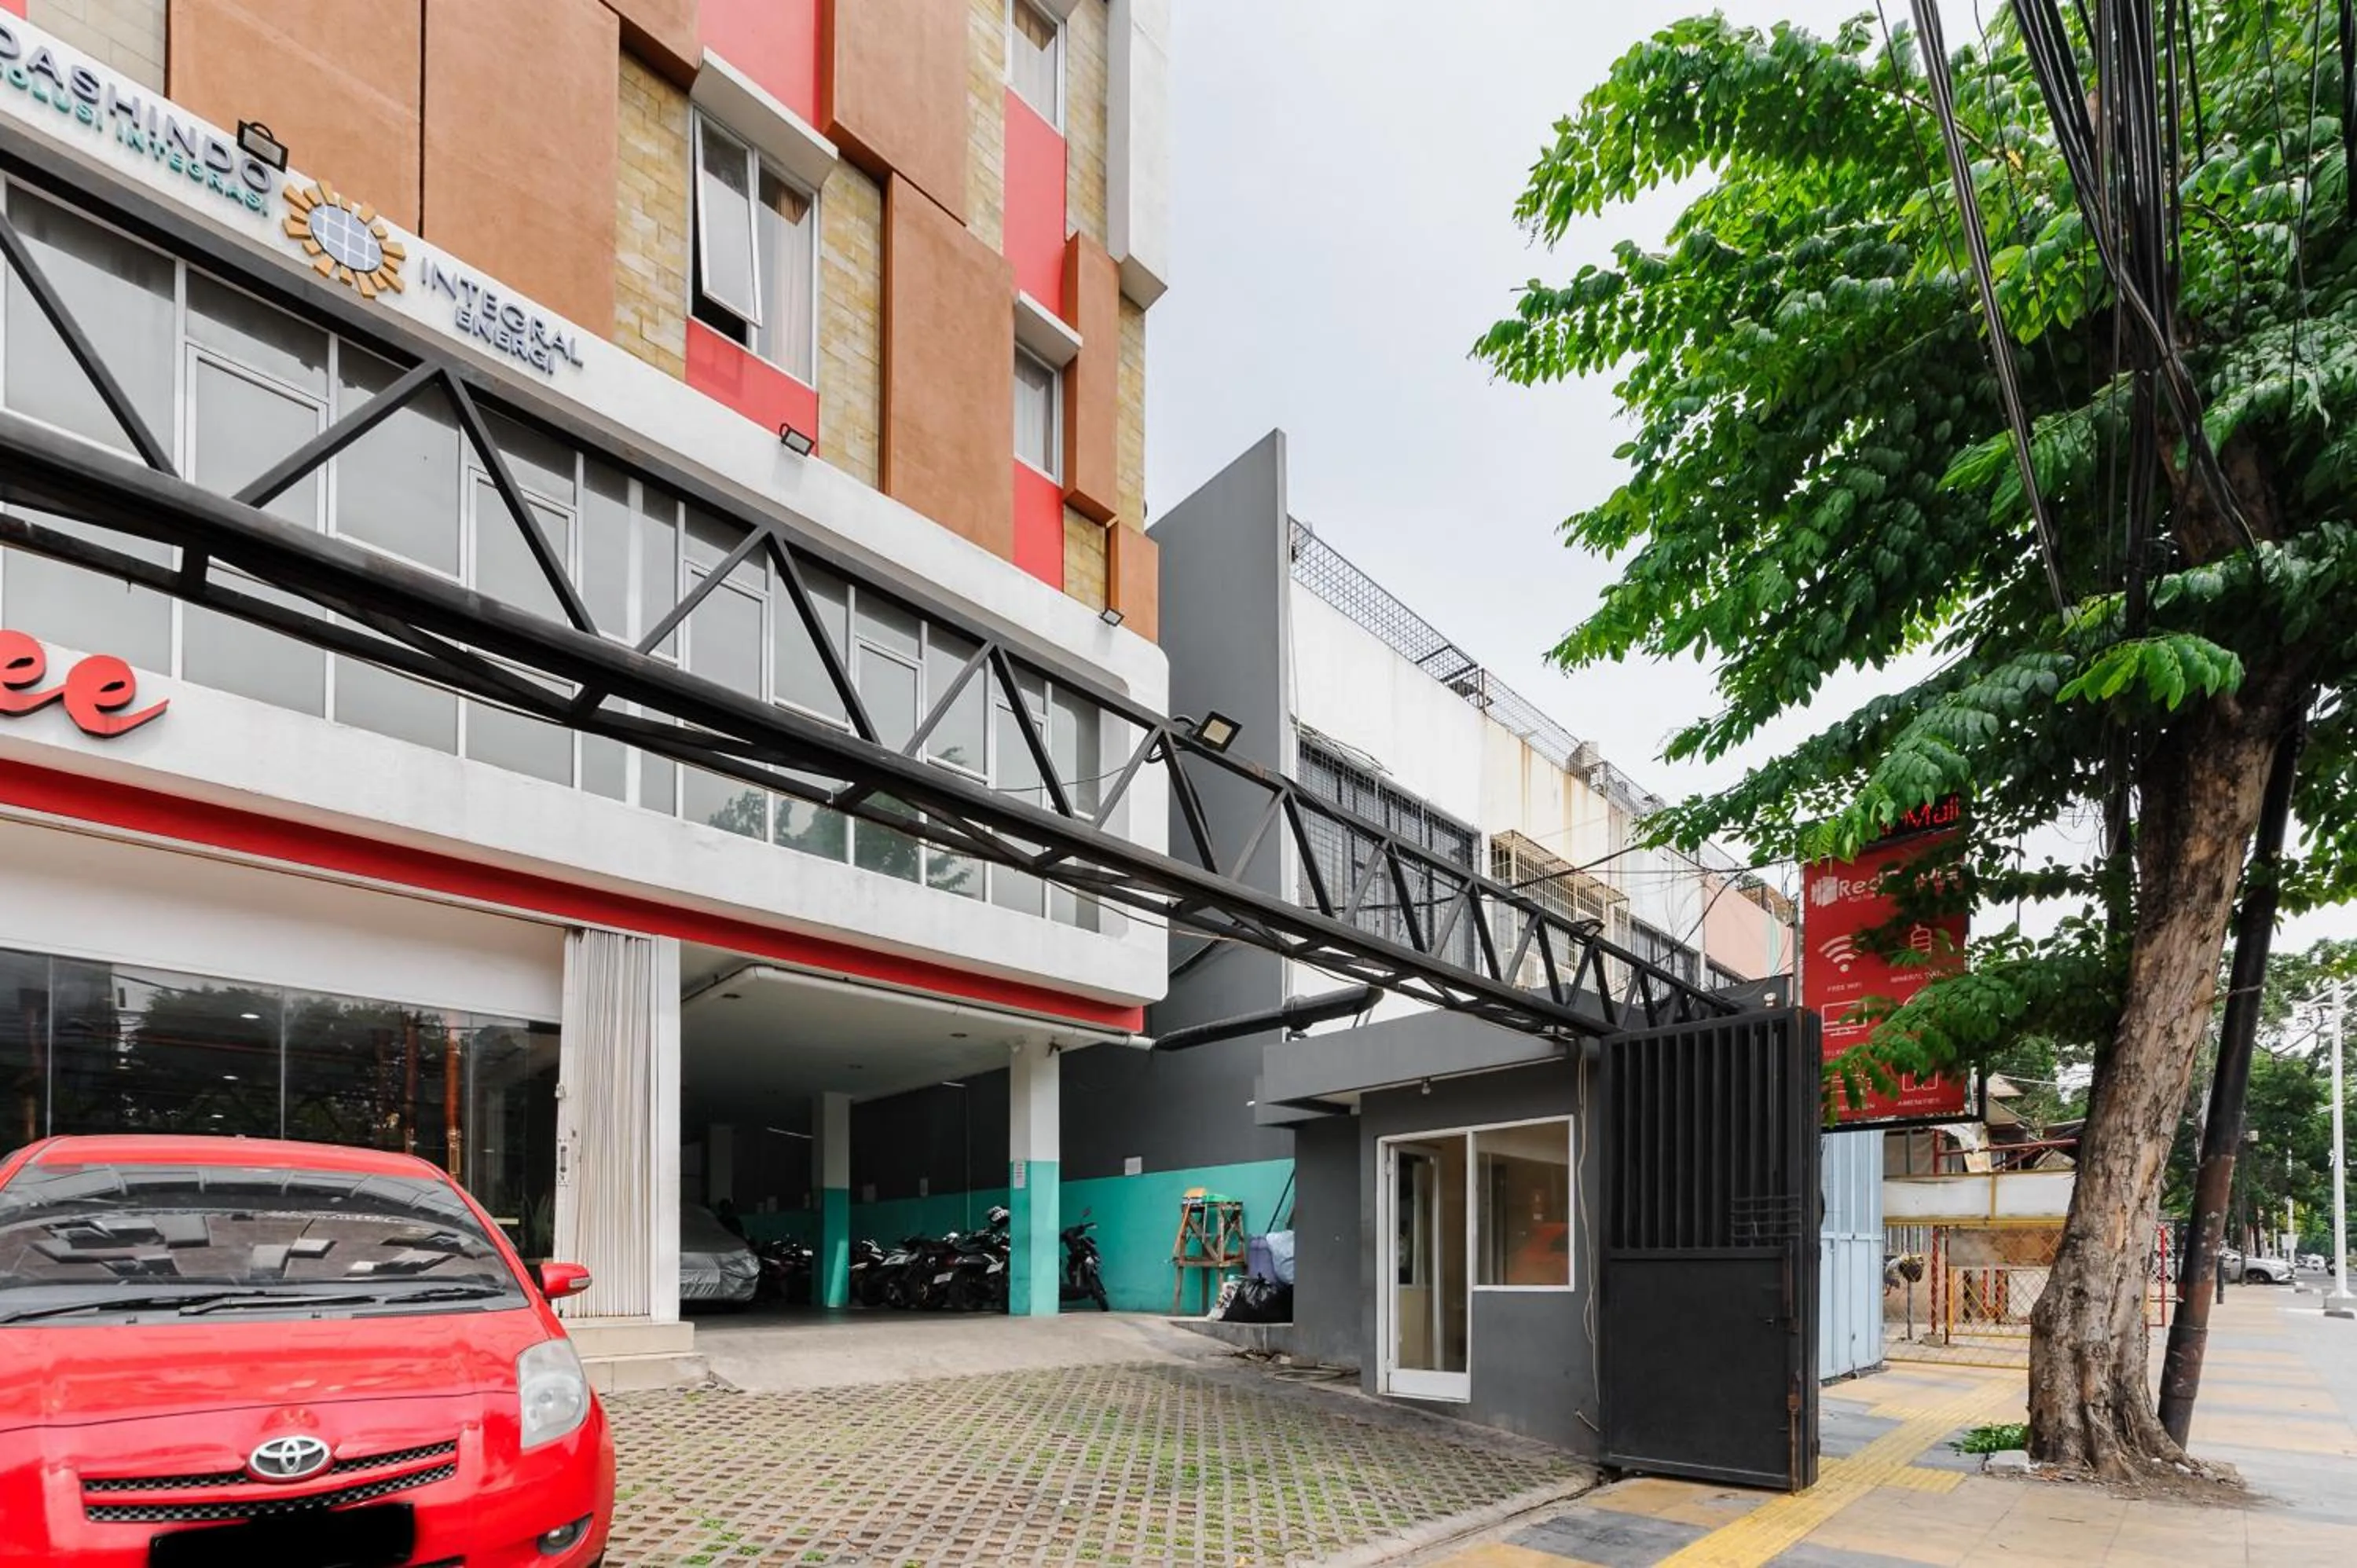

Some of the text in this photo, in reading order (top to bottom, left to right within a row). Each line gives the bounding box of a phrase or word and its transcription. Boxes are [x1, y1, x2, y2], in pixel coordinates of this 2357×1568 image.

[0, 62, 269, 218] OLUSI INTEGRASI
[420, 256, 584, 369] INTEGRAL
[455, 305, 555, 376] ENERGI
